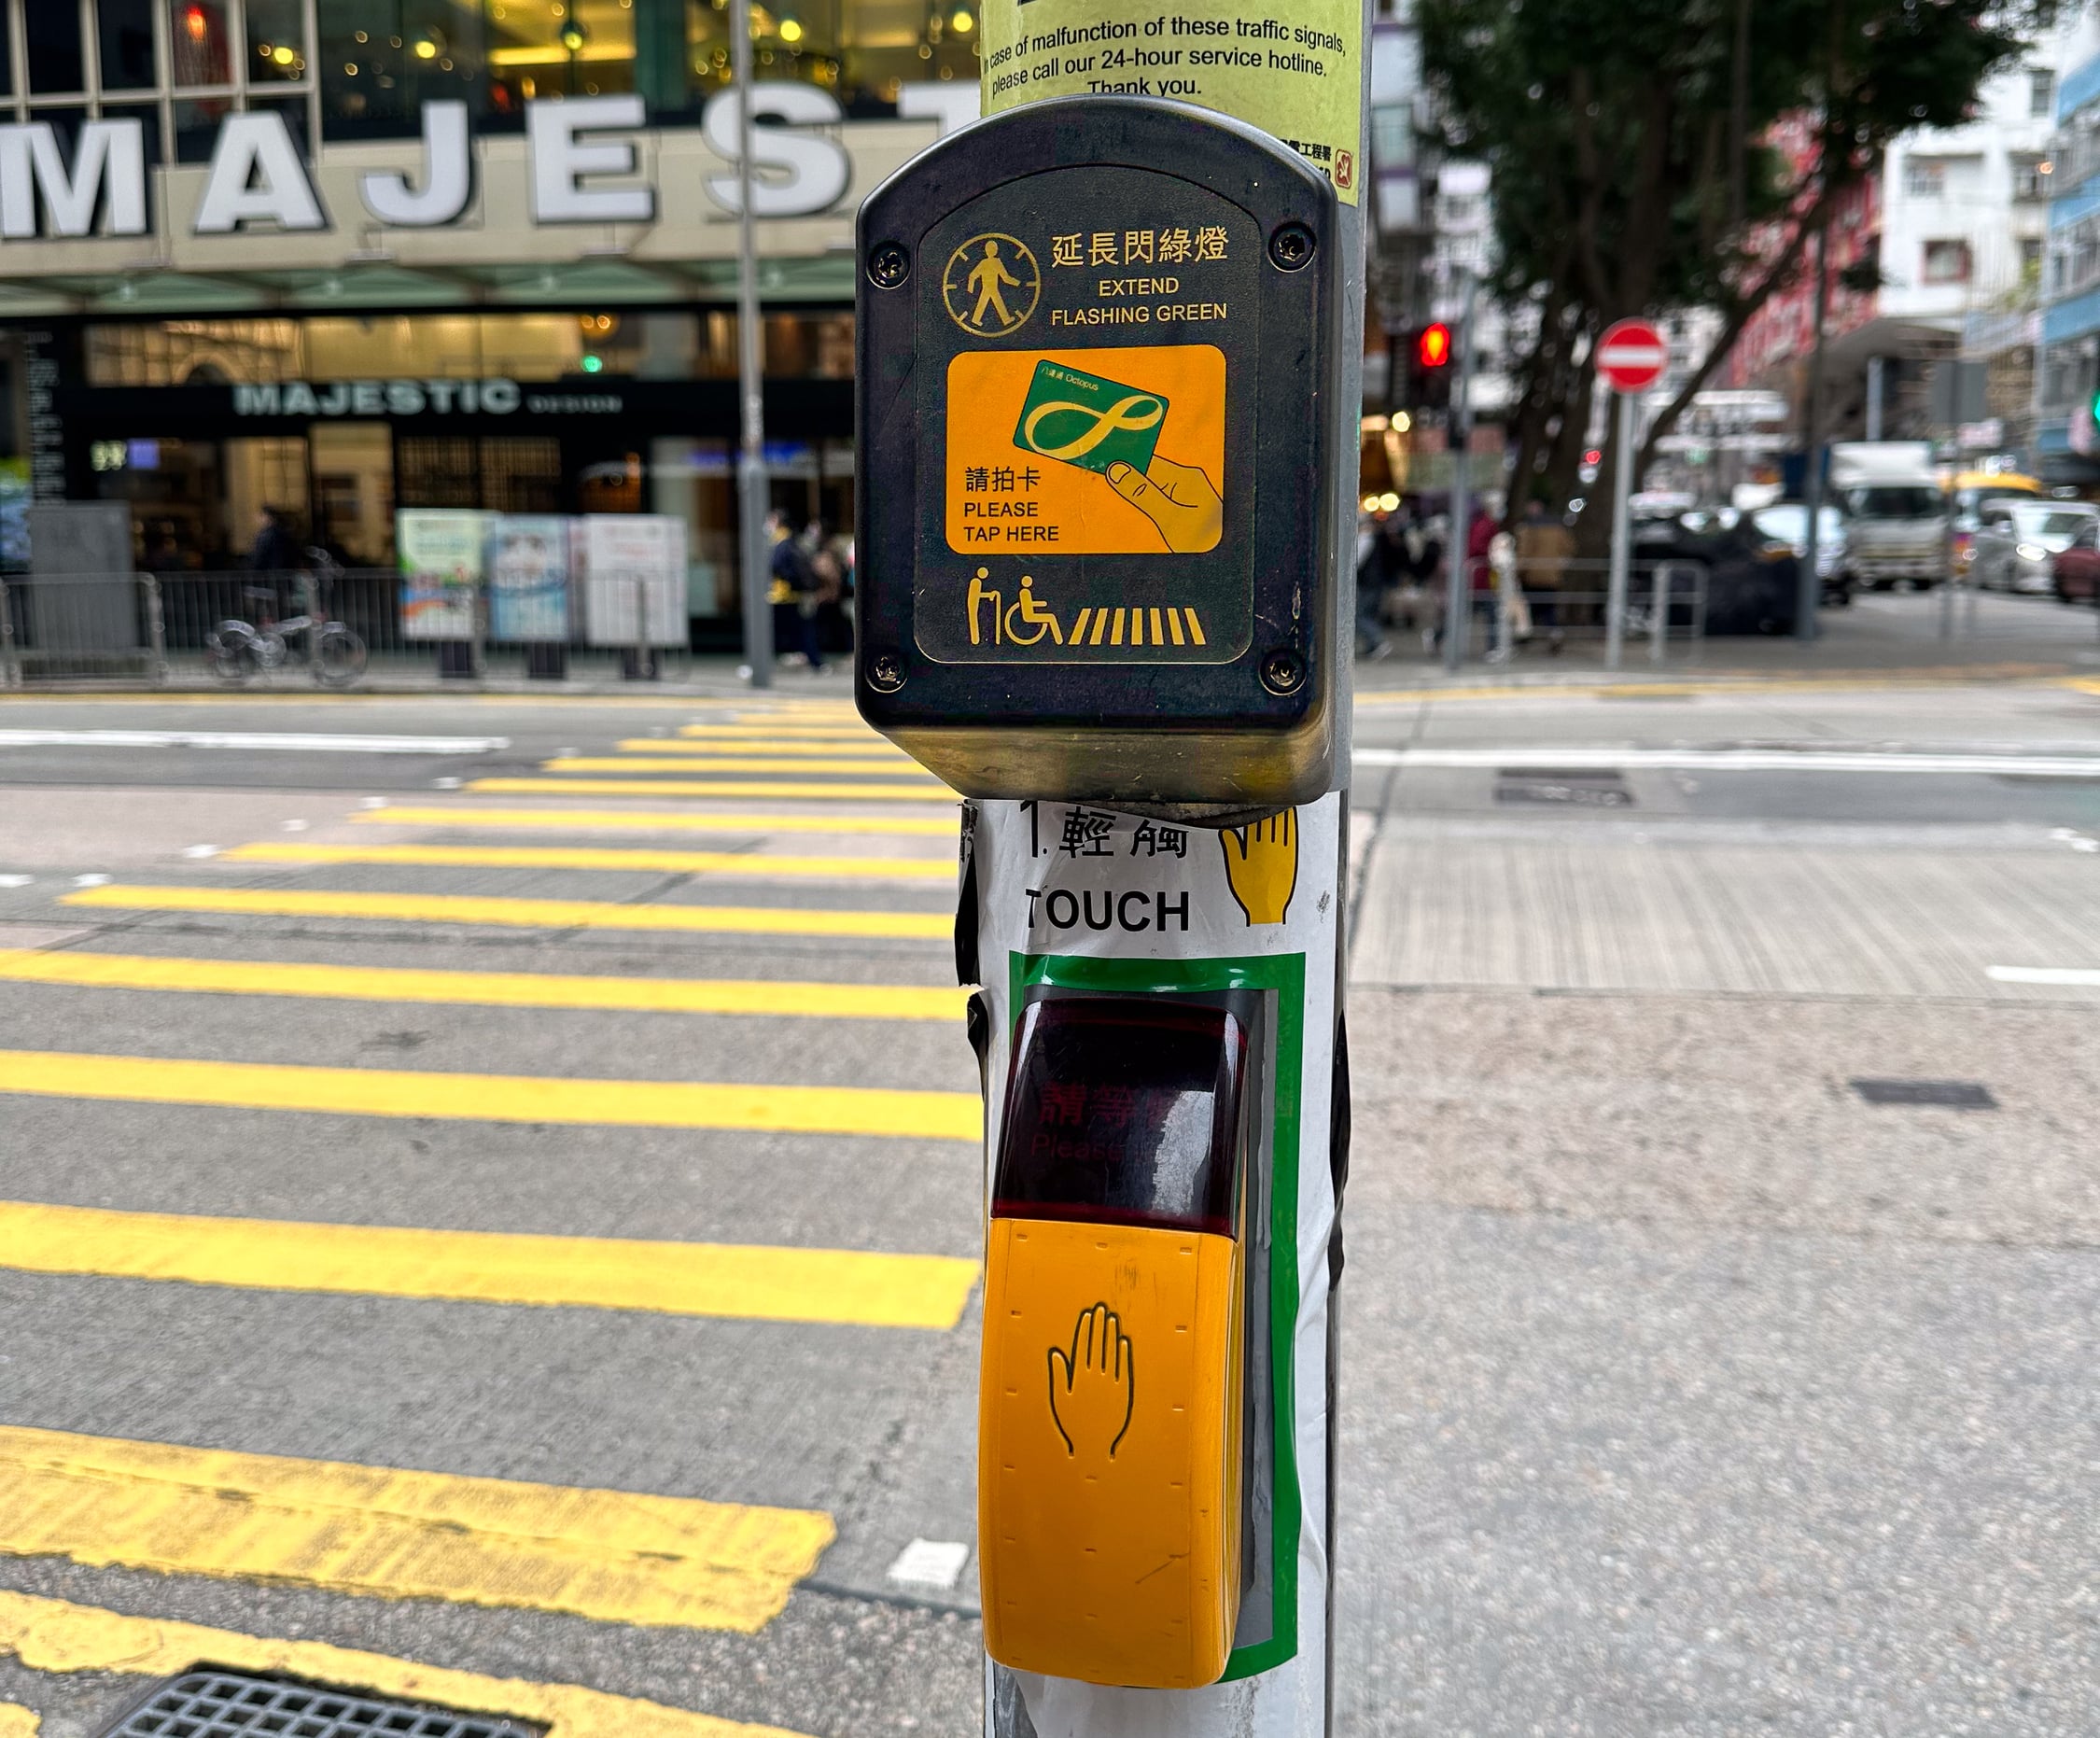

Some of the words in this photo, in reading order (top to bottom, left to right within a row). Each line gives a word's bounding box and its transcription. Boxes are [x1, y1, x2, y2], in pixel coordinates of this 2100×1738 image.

[989, 46, 1012, 68] case
[1015, 35, 1029, 57] of
[1032, 21, 1137, 52] malfunction
[1144, 16, 1166, 35] of
[1171, 16, 1229, 35] these
[1236, 18, 1289, 40] traffic
[1295, 25, 1346, 57] signals,
[992, 69, 1028, 100] please
[1032, 58, 1058, 80] call
[1065, 56, 1096, 75] our
[1101, 48, 1183, 69] 24-hour
[1189, 47, 1262, 66] service
[1268, 49, 1326, 77] hotline.
[1087, 77, 1151, 95] Thank
[1158, 79, 1202, 97] you.
[1280, 139, 1331, 162] 電工程署
[1052, 226, 1229, 268] 延長閃綠燈
[1099, 277, 1180, 297] EXTEND
[1052, 306, 1150, 326] FLASHING
[1156, 302, 1227, 322] GREEN
[1065, 373, 1099, 391] Octopus
[233, 378, 521, 416] MAJESTIC
[964, 466, 1041, 492] 請拍卡
[964, 502, 1039, 517] PLEASE
[963, 526, 1001, 541] TAP
[1007, 526, 1059, 541] HERE
[1026, 889, 1189, 932] TOUCH
[1030, 1133, 1125, 1162] Please
